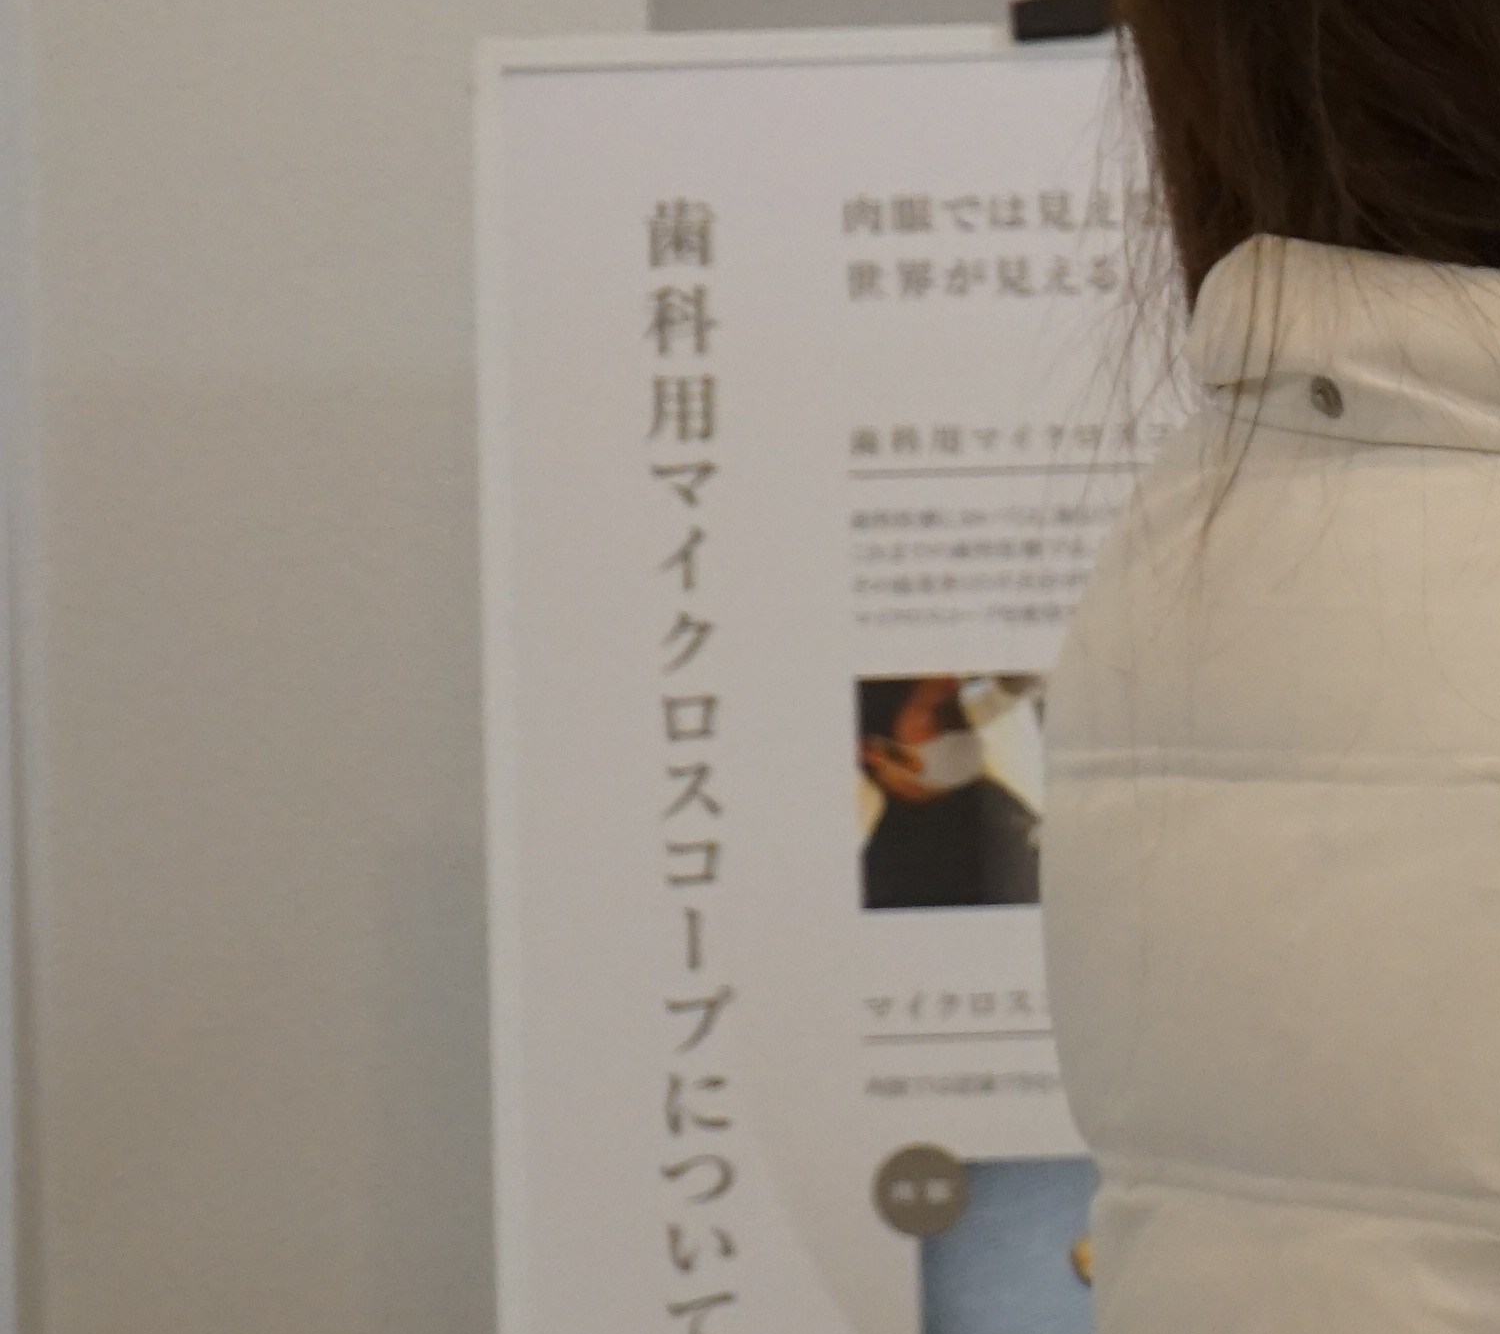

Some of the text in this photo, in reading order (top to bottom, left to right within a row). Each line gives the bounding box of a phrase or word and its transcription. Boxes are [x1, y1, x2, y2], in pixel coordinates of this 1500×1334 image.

[847, 253, 1120, 302] 世界が見える
[862, 988, 1052, 1019] マイクロス
